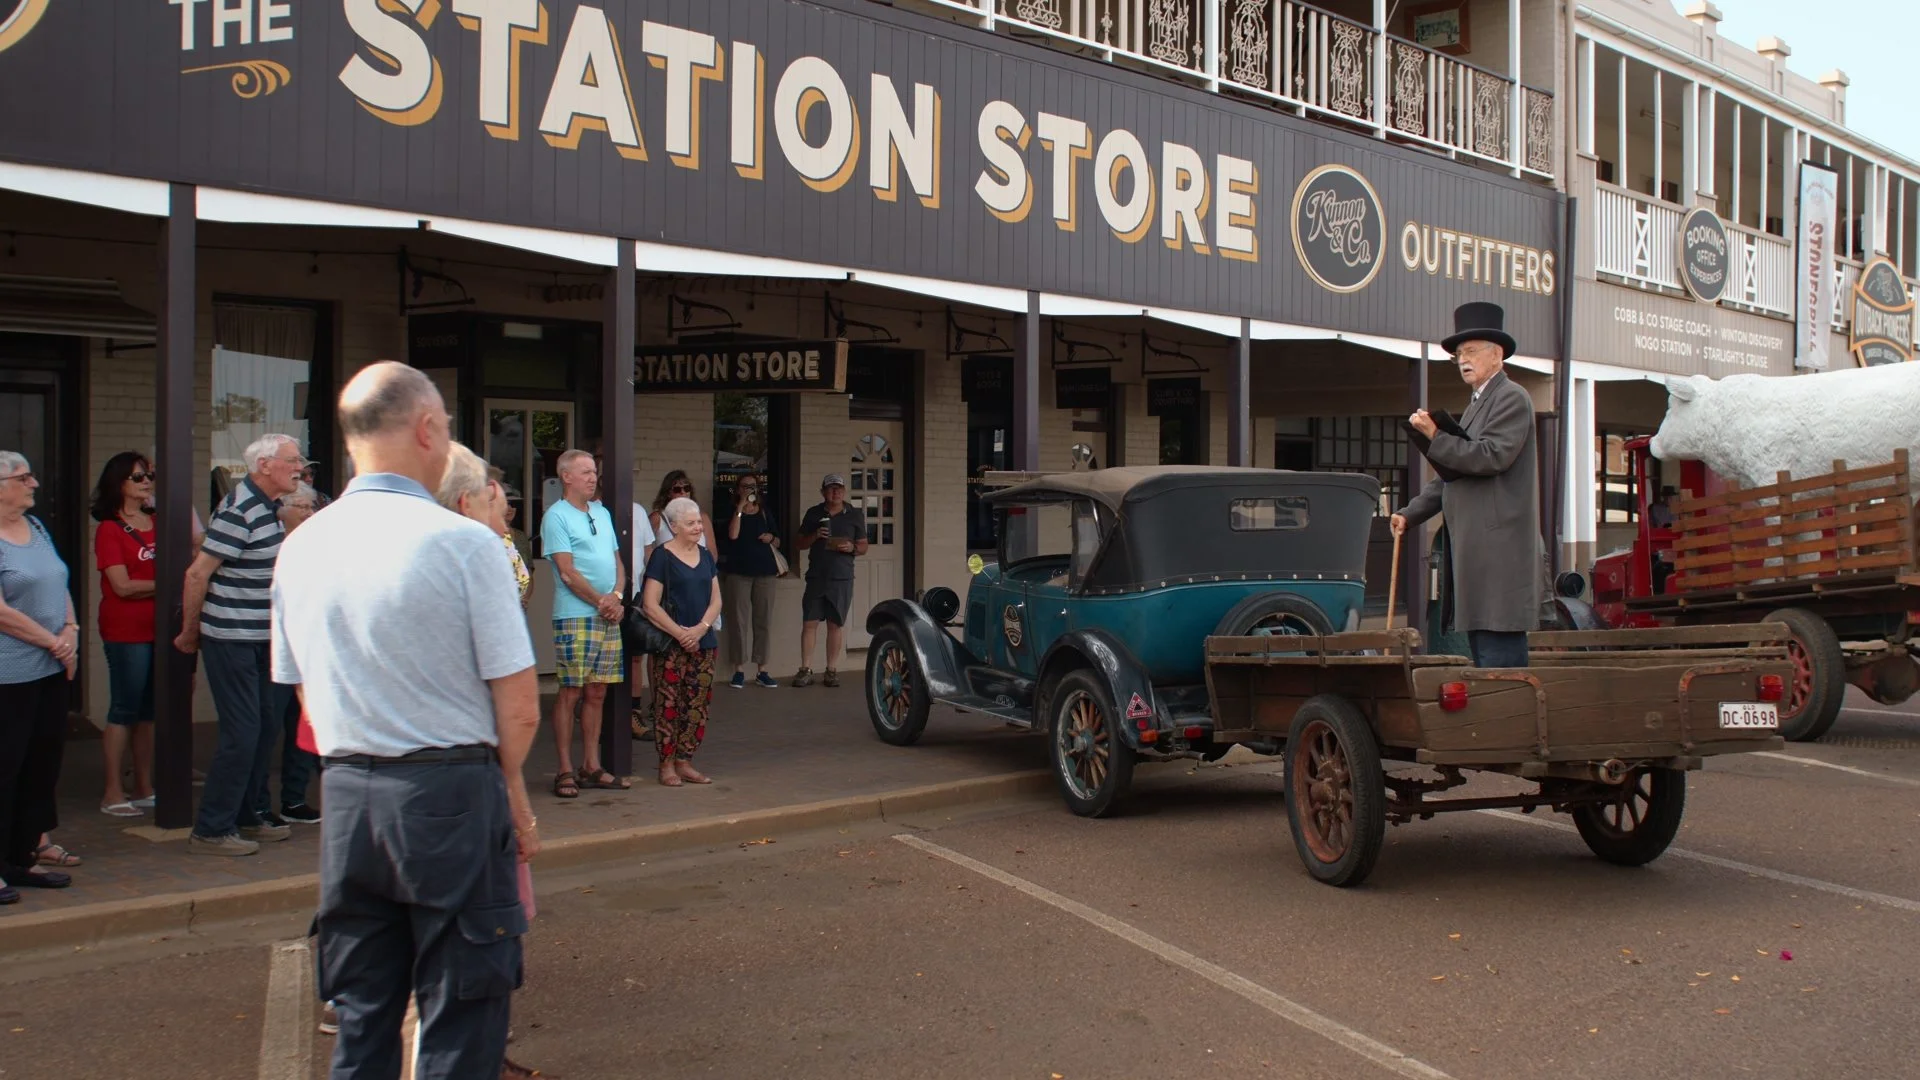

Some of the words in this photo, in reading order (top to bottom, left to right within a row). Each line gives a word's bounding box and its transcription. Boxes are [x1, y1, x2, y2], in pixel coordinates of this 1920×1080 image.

[169, 0, 293, 51] THE
[338, 0, 940, 208] STATION
[975, 100, 1258, 262] STORE
[1306, 189, 1366, 242] Kinnon
[1330, 226, 1344, 253] &
[1686, 225, 1725, 256] BOOKING
[1401, 220, 1555, 296] OUTFITTERS
[1690, 262, 1722, 284] EXPERIENCES
[1696, 249, 1716, 266] OFFICE
[1614, 306, 1637, 324] COBB
[1638, 311, 1645, 326] &
[1646, 313, 1658, 329] CO
[1659, 316, 1684, 333] STAGE
[1685, 320, 1712, 338] COACH
[1720, 327, 1748, 345] WINTON
[1749, 331, 1784, 352] DISCOVERY
[634, 353, 729, 382] STATION
[736, 350, 820, 382] STORE
[1634, 334, 1660, 350] NOGO
[1660, 338, 1692, 357] STATION
[1745, 353, 1769, 369] CRUISE
